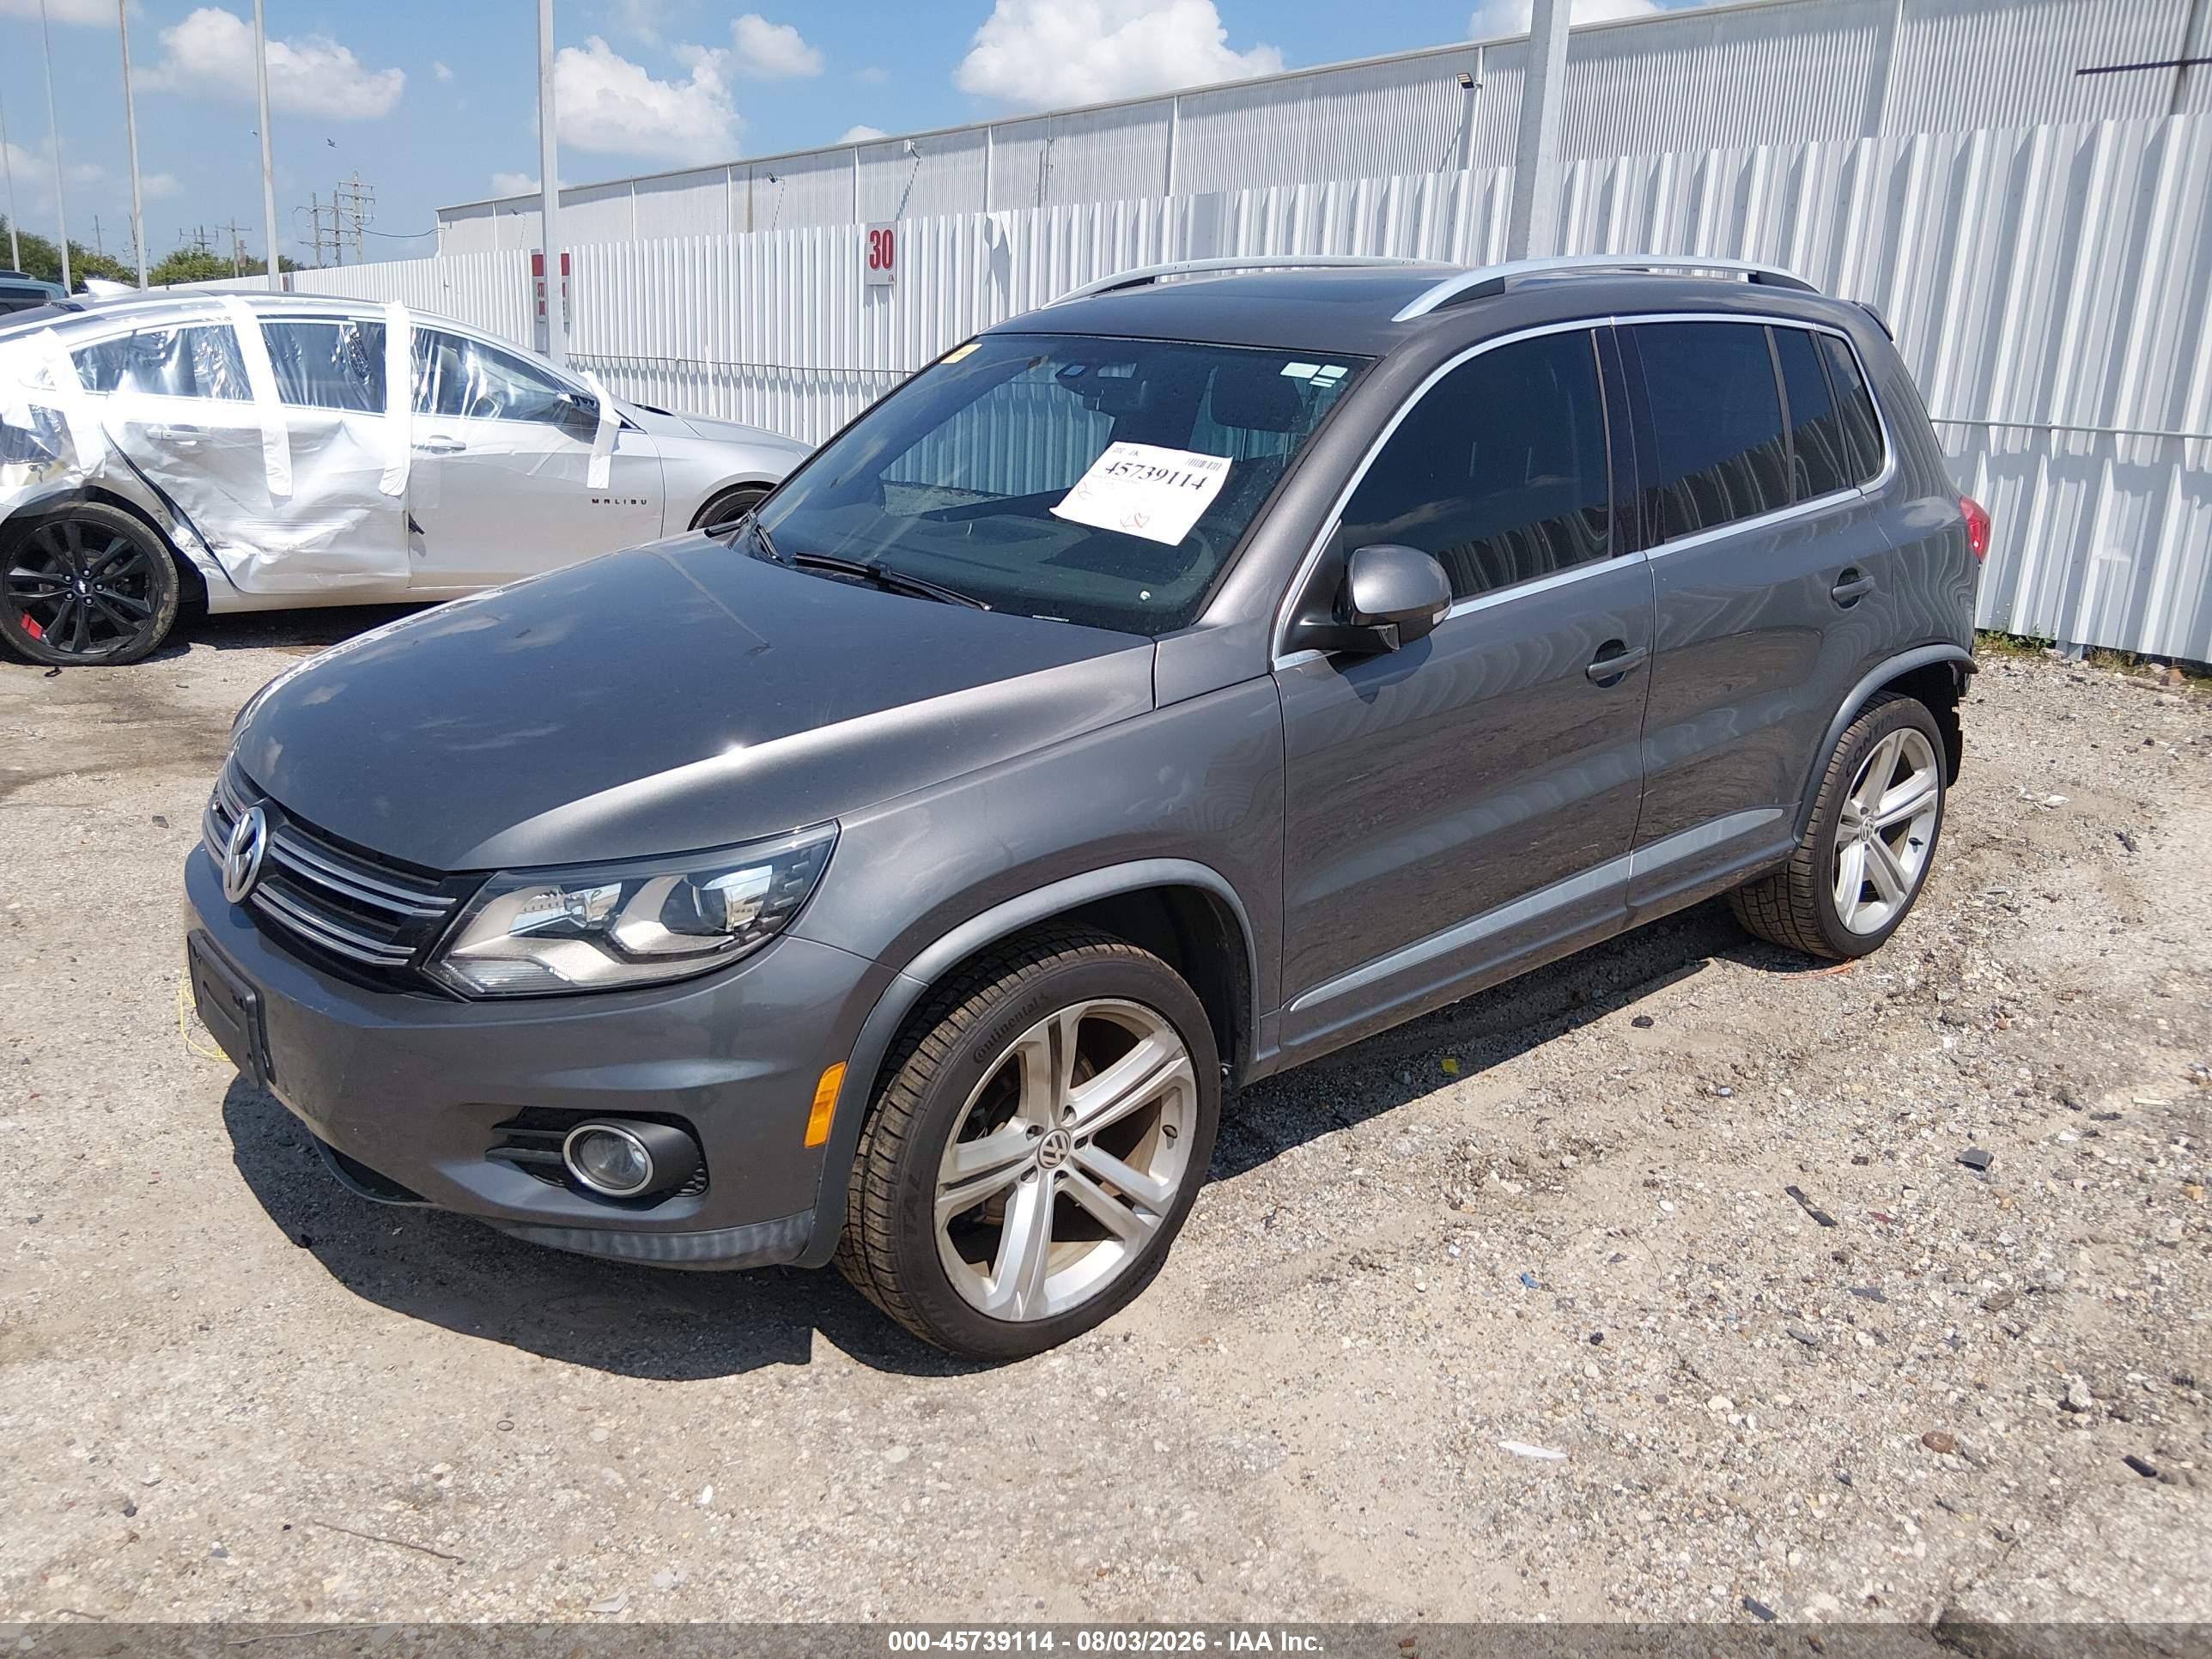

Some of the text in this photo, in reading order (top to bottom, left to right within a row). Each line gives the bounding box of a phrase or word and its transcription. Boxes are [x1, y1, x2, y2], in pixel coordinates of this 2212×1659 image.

[870, 229, 894, 270] 30
[1105, 461, 1208, 490] 45739114
[973, 996, 1039, 1064] Continental
[1038, 1128, 1071, 1169] VW
